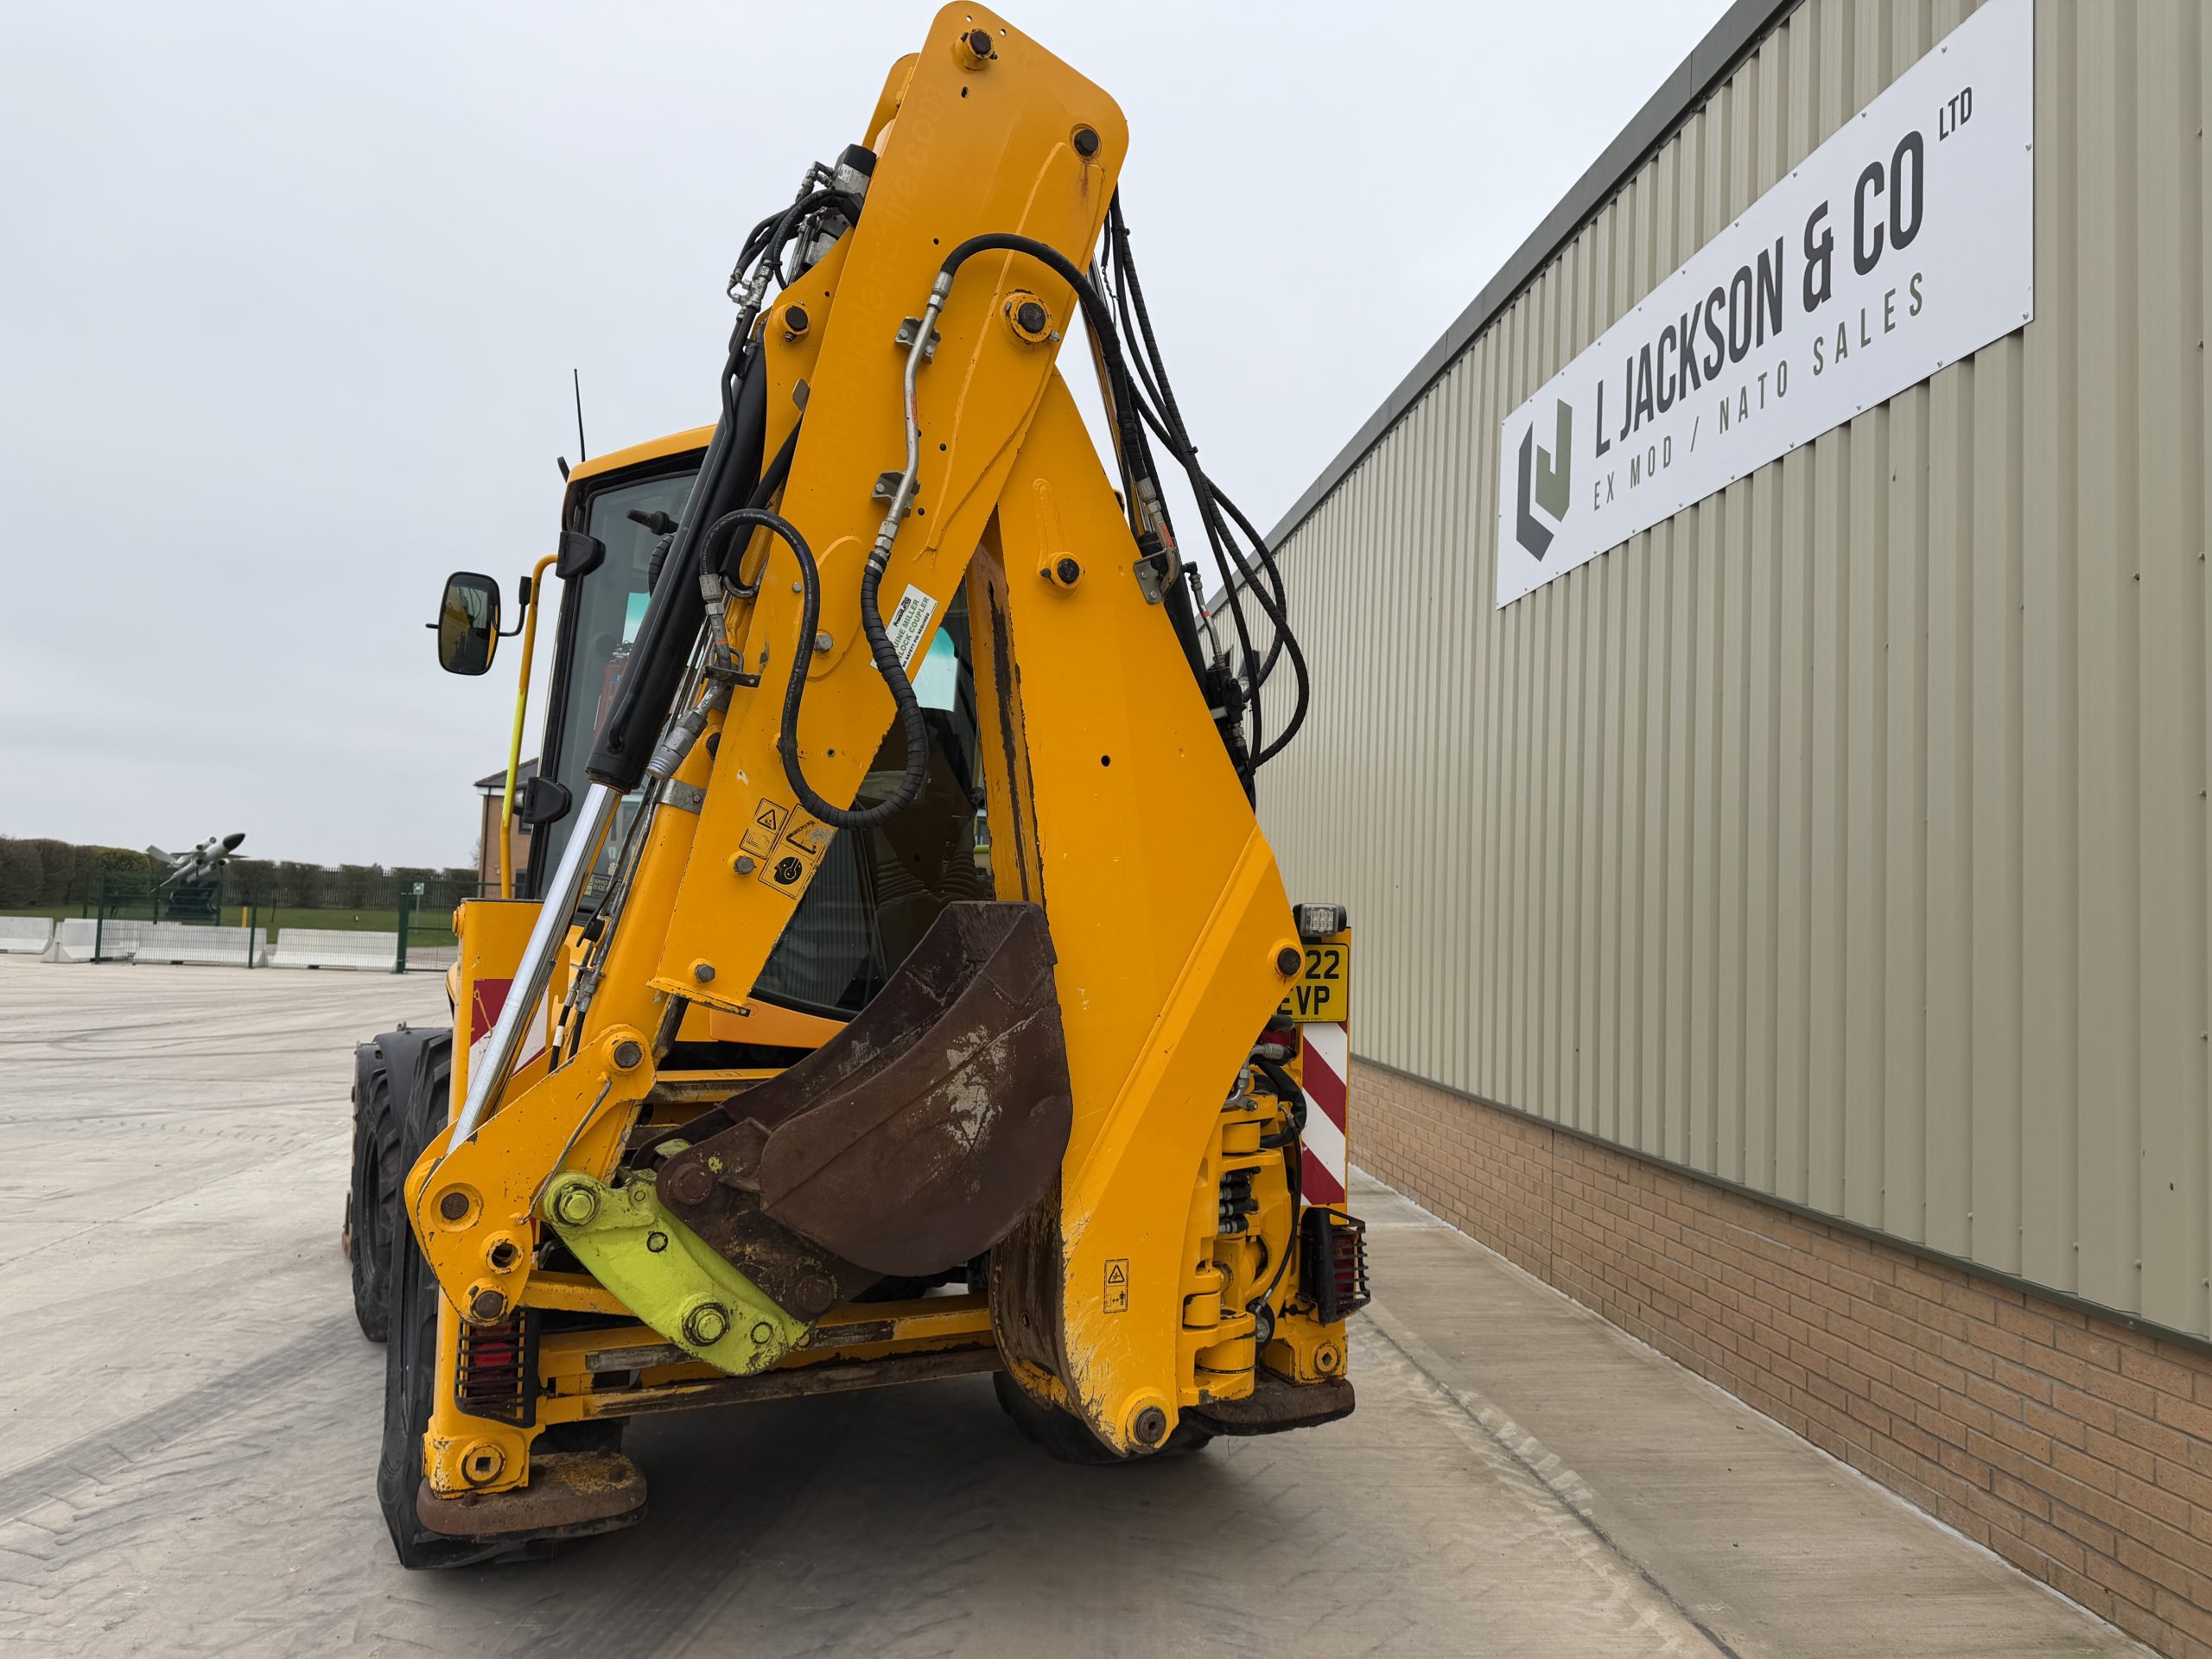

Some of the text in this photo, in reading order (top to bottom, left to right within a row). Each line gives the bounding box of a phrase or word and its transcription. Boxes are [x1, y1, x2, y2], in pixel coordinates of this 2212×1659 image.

[1596, 87, 1973, 459] L JACKSON & CO LTD
[1594, 272, 1923, 512] EX MOD / NATO SALES
[894, 628, 906, 648] UINE
[902, 599, 919, 628] MILLER
[899, 597, 930, 659] NLOCK COUPLER
[906, 644, 916, 660] SAFETY
[918, 612, 930, 634] REQUIRED
[1276, 985, 1330, 1015] EVP
